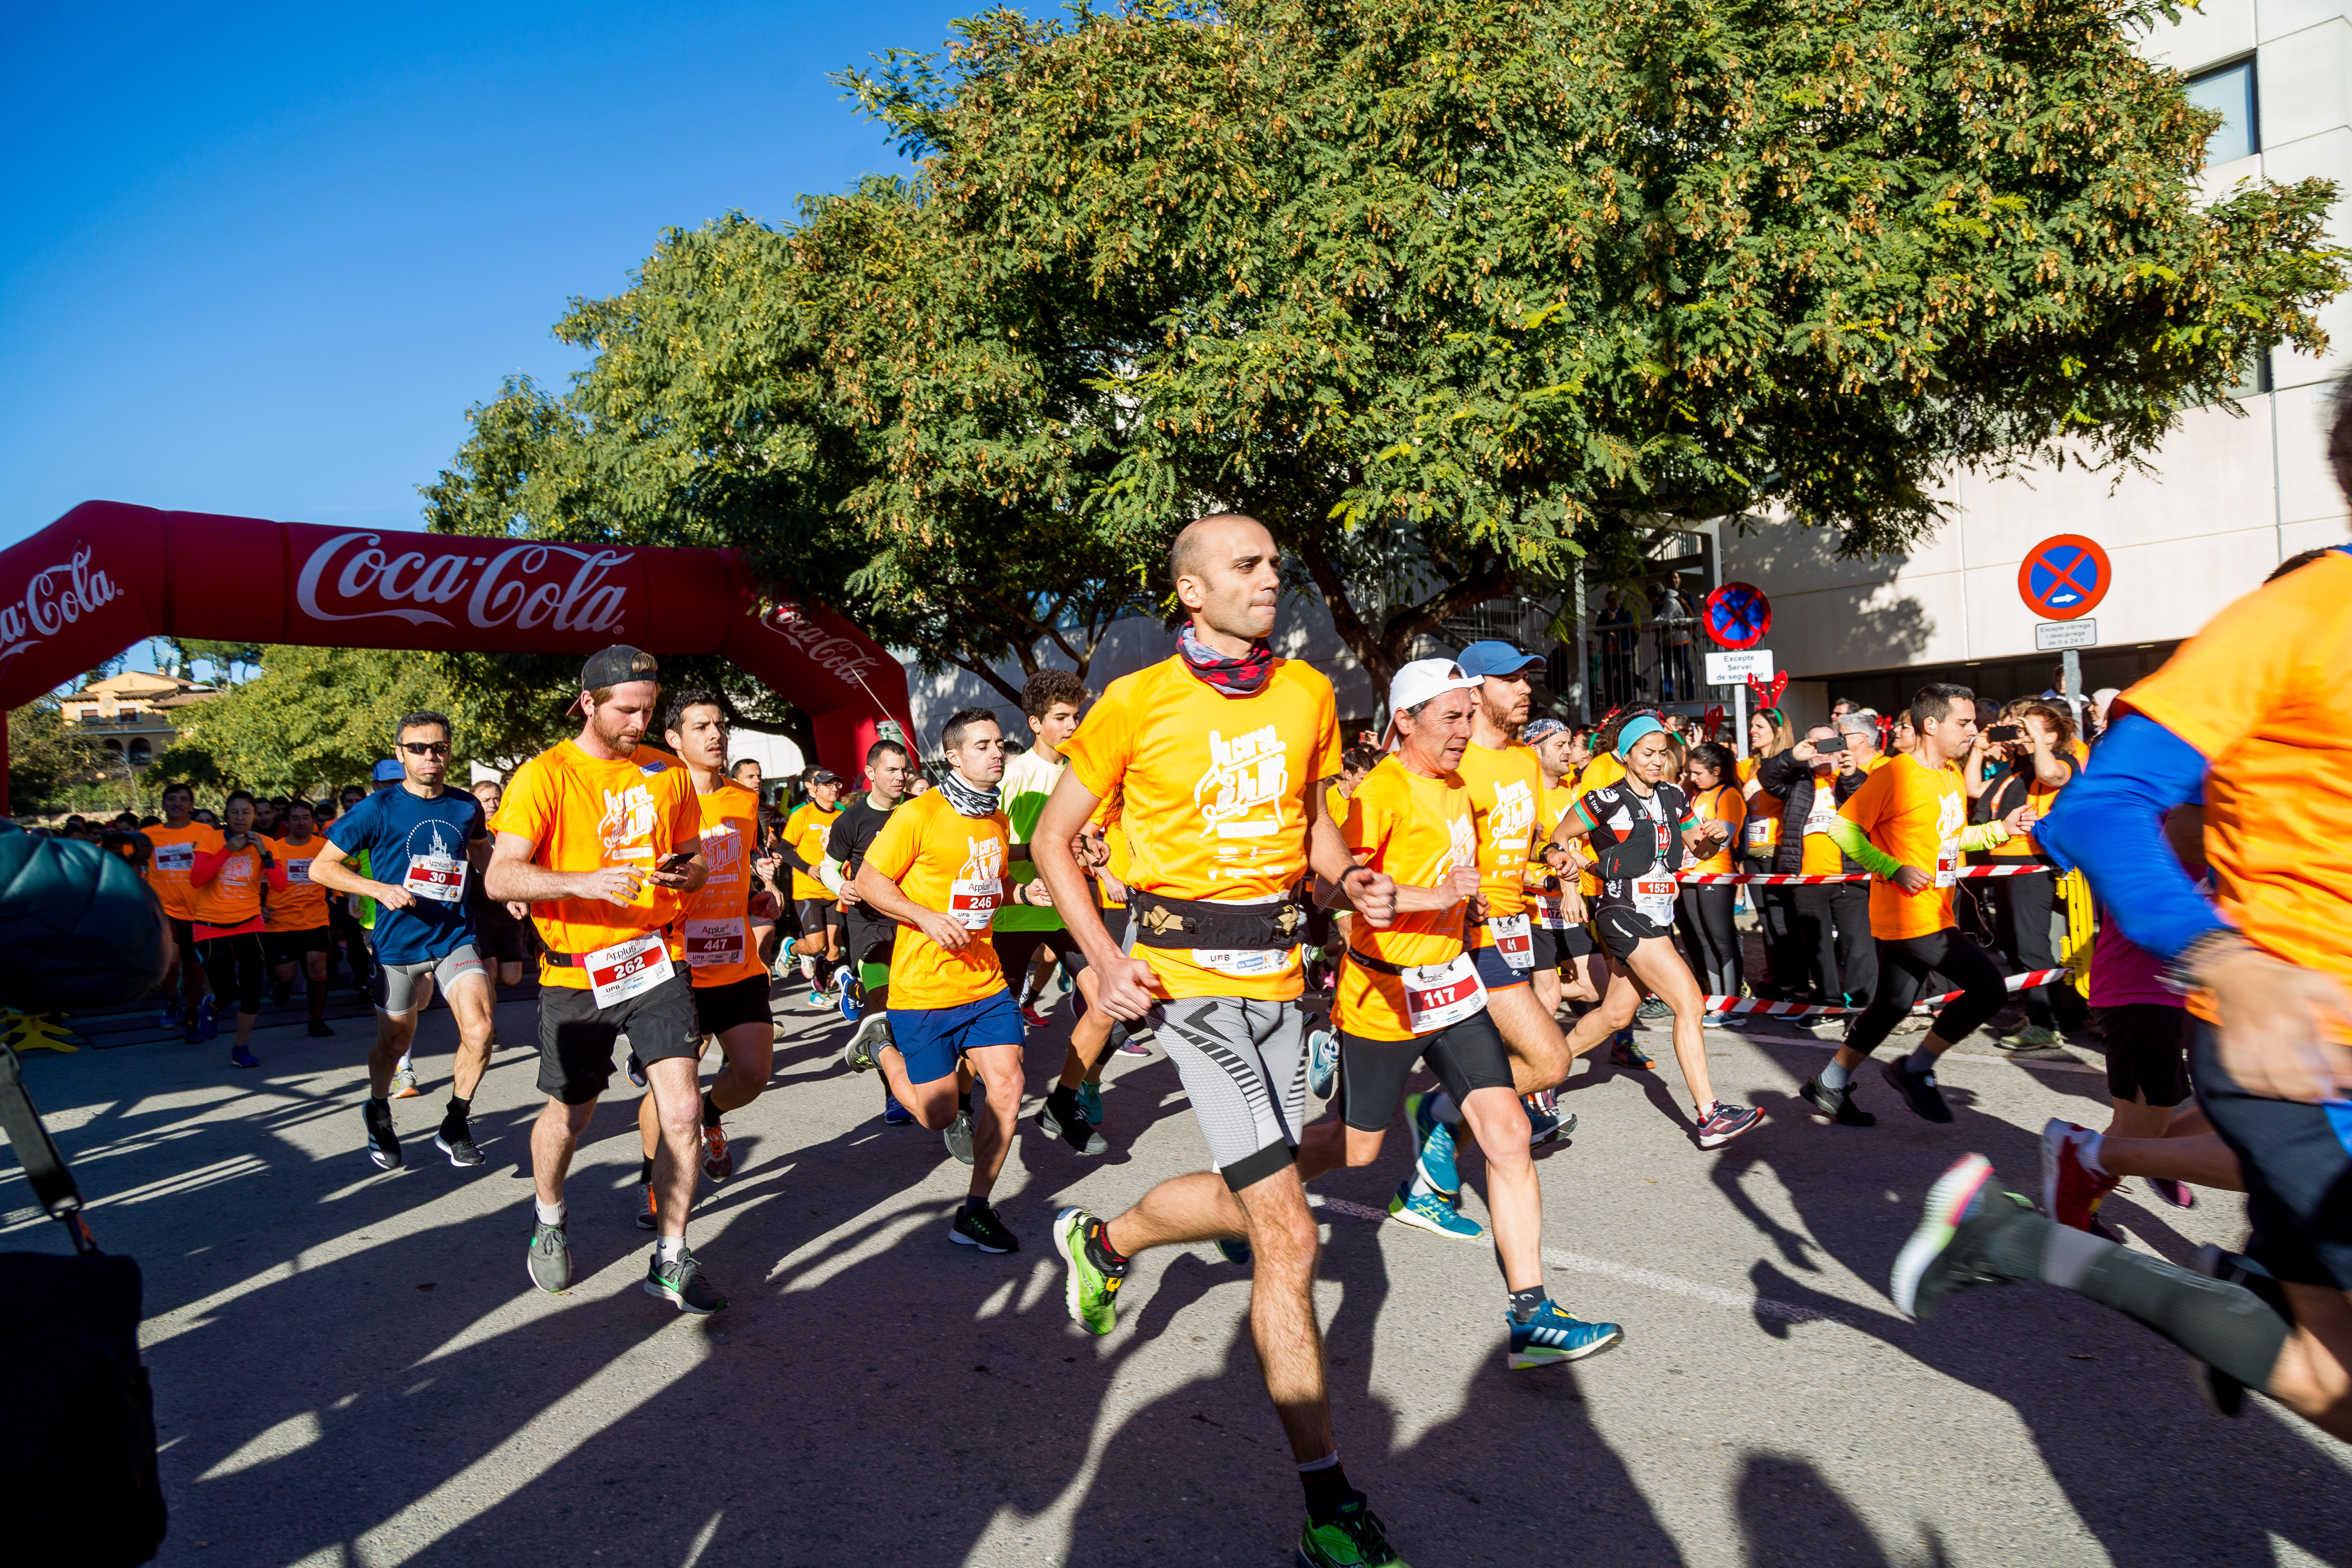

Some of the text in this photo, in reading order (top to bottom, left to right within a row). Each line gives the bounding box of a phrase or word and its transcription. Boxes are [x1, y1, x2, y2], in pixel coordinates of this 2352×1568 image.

[297, 532, 635, 632] Coca-Cola
[1591, 800, 1602, 814] trail
[429, 872, 446, 883] 30
[968, 883, 990, 893] Applus
[1648, 883, 1669, 893] 1521
[969, 896, 992, 909] 246
[702, 926, 725, 936] Applus
[704, 938, 727, 951] 447
[1507, 938, 1517, 951] 41
[606, 944, 637, 961] Applus
[621, 947, 645, 961] laboratories
[614, 956, 646, 980] 262
[1424, 987, 1455, 1007] 117
